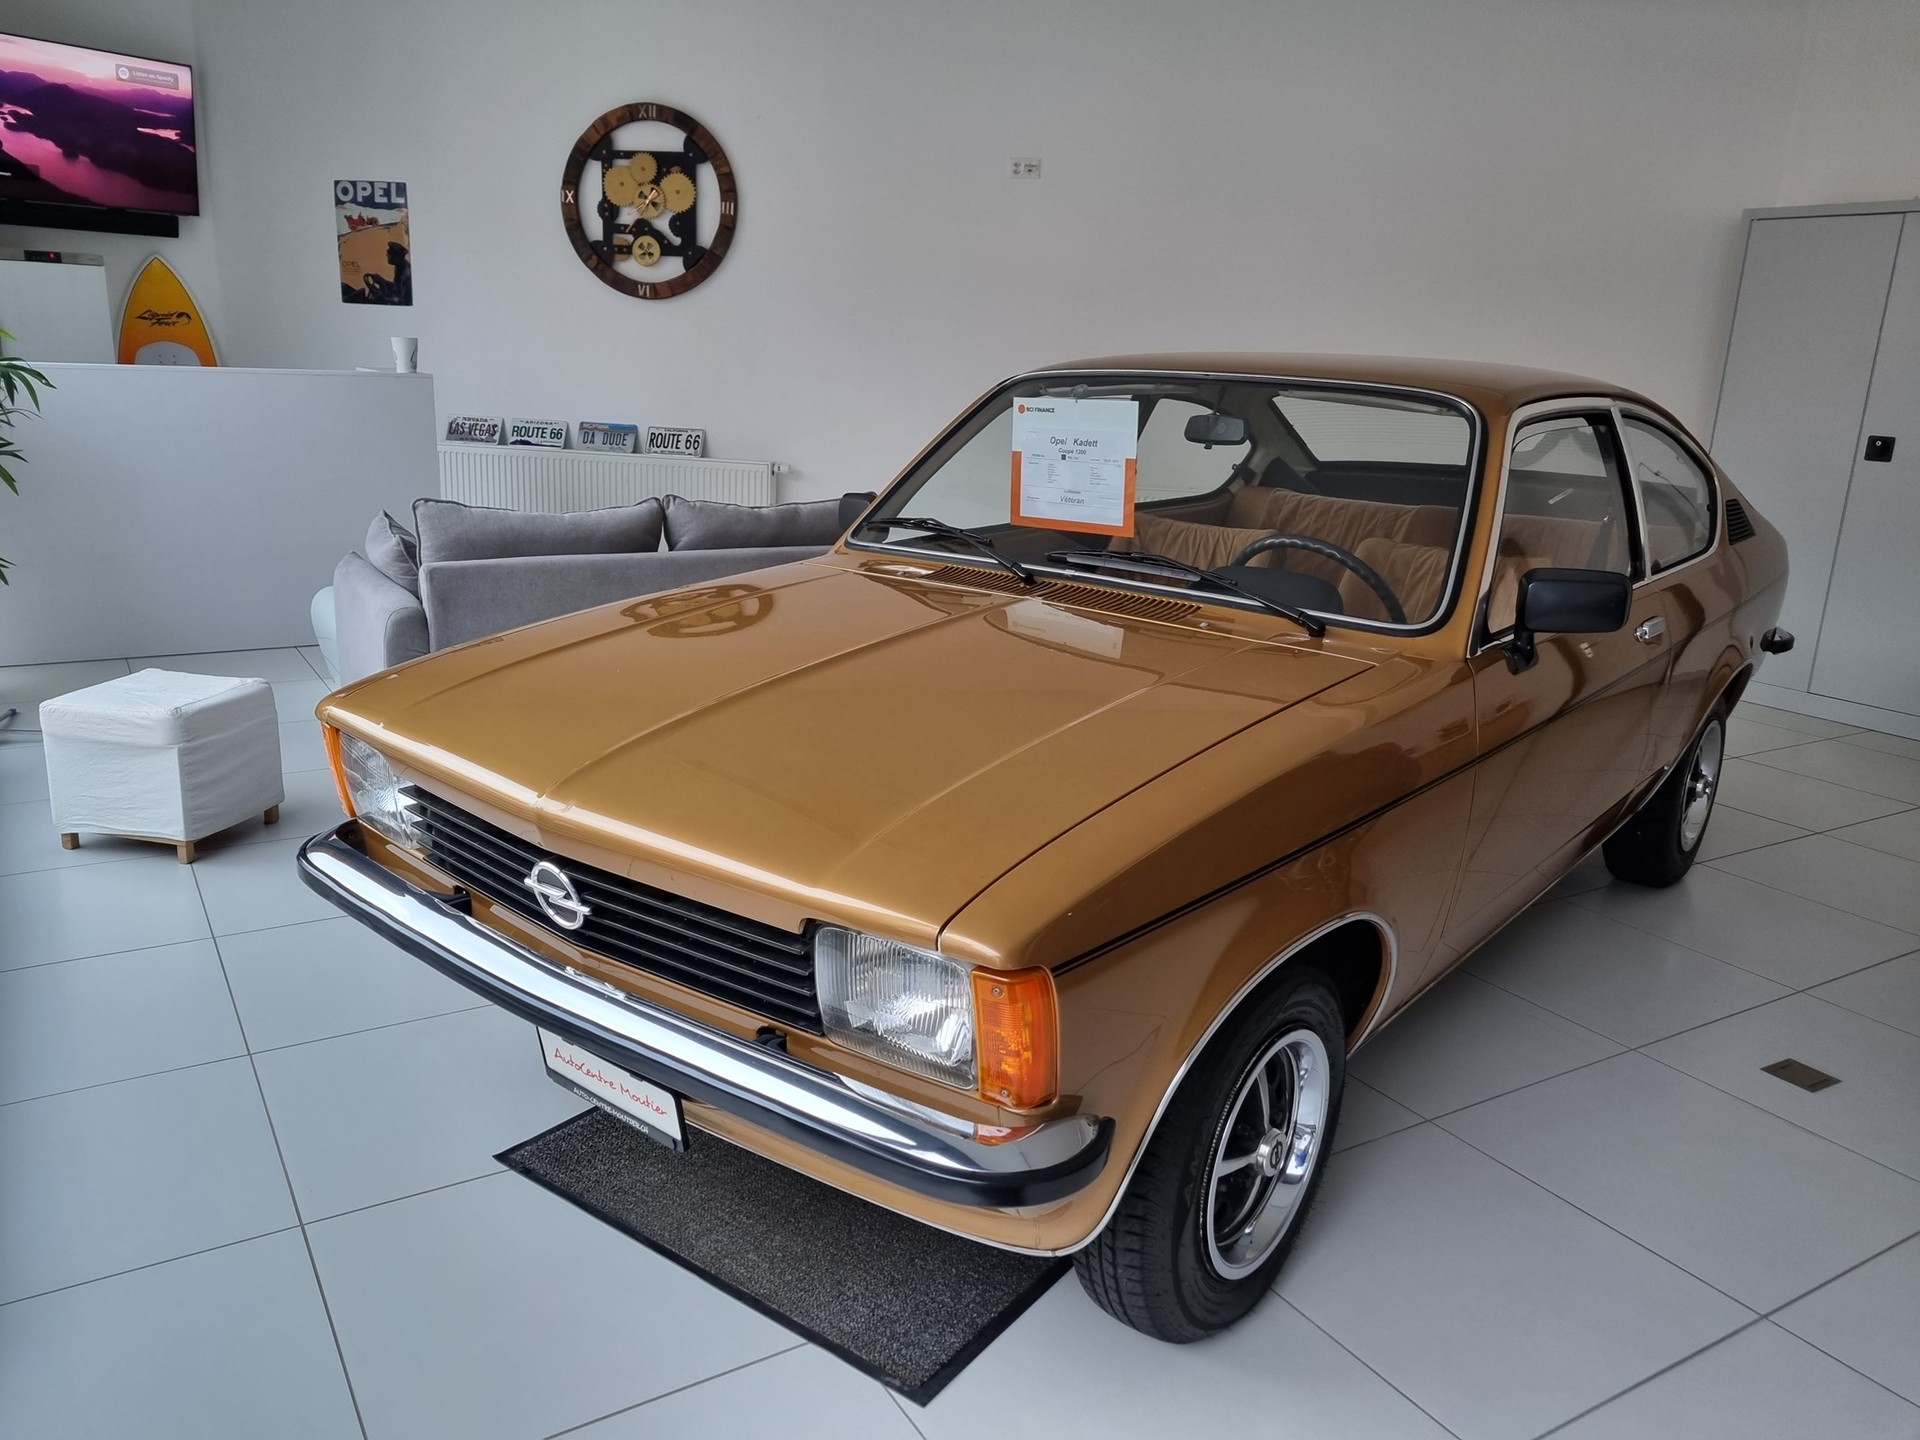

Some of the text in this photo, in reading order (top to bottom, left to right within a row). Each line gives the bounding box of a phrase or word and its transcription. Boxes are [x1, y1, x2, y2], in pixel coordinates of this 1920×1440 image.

[156, 74, 174, 82] Spotify
[638, 104, 656, 118] XII
[335, 180, 406, 204] OPEL
[561, 190, 574, 203] IX
[721, 201, 735, 216] III
[342, 260, 360, 268] OPEL
[448, 421, 499, 437] LAS VEGAS
[511, 425, 564, 440] ROUTE 66
[582, 431, 629, 446] DA DUDE
[648, 432, 701, 450] ROUTE 66
[1049, 436, 1098, 448] Opel Kadett
[554, 1047, 668, 1116] AutoCentre Moutier
